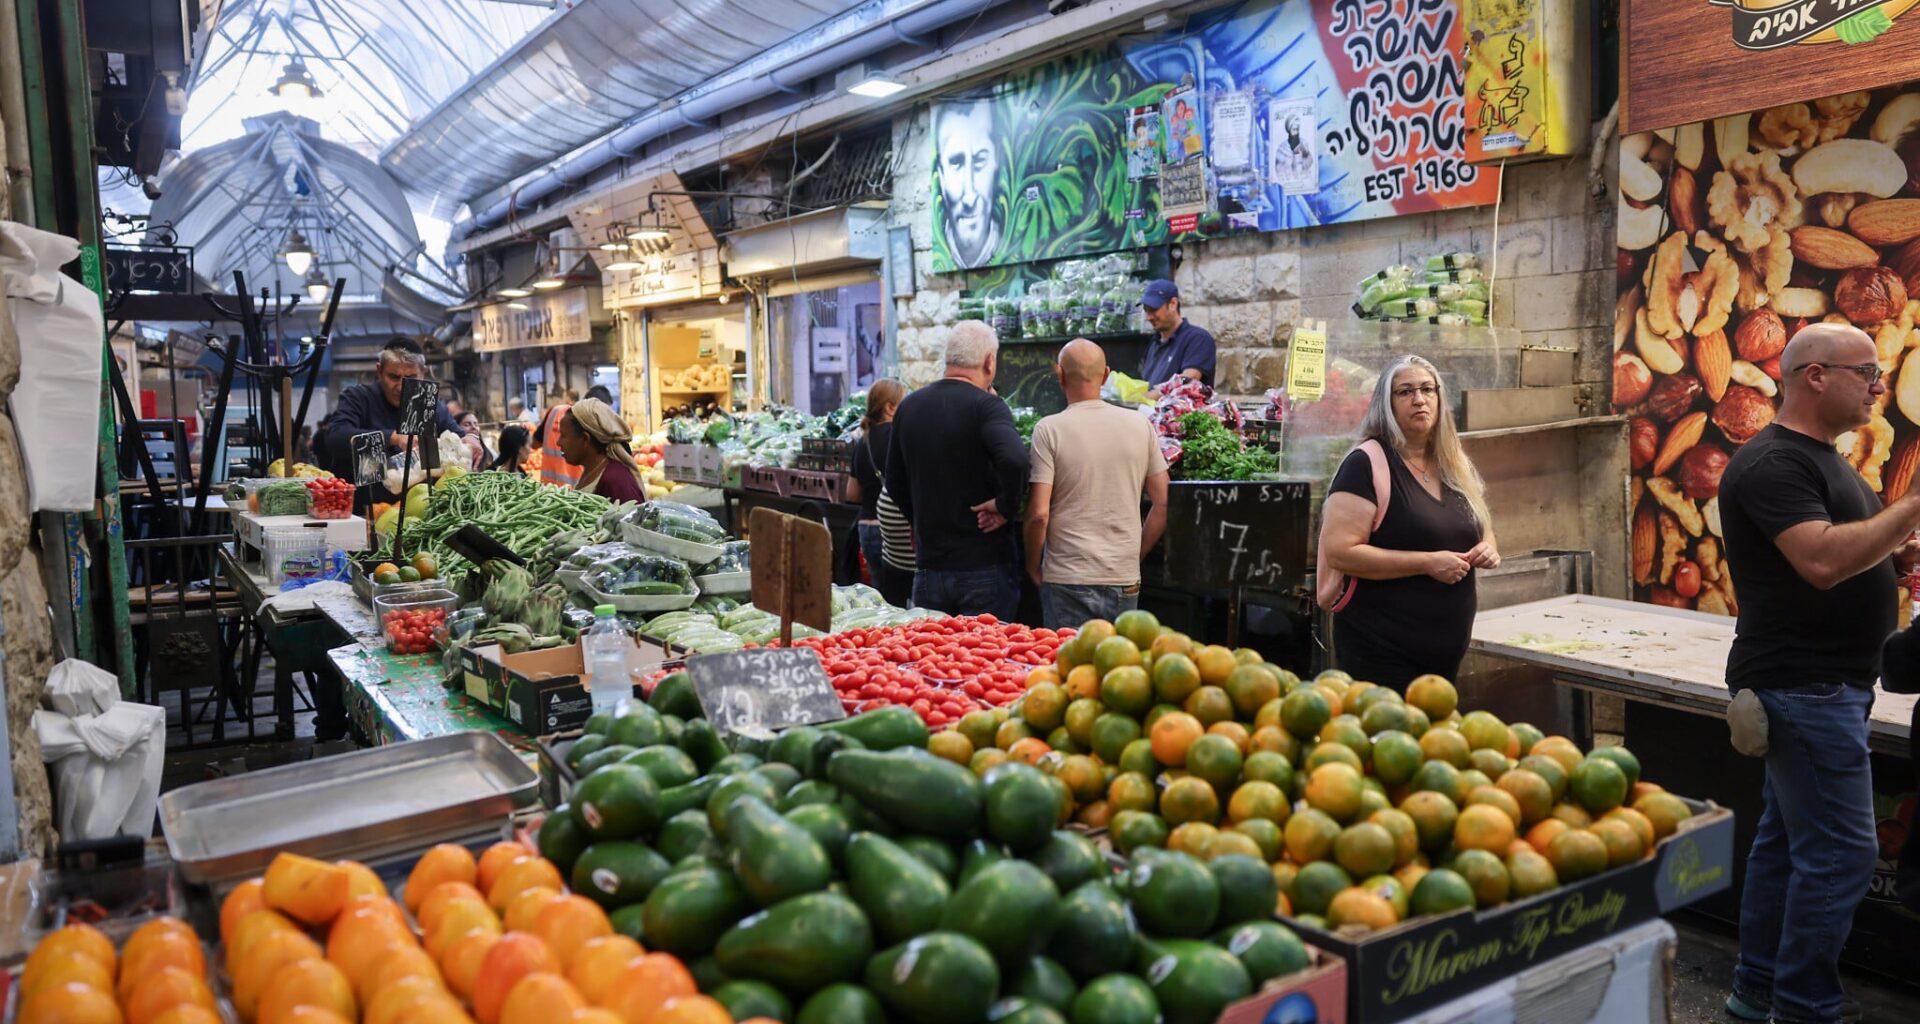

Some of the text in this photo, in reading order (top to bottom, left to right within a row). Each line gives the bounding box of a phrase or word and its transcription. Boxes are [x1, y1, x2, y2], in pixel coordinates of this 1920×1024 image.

[1347, 10, 1454, 67] משה
[1325, 91, 1465, 157] טרוזיליה
[1364, 160, 1476, 202] EST 1960
[1219, 520, 1249, 581] 7
[1381, 888, 1627, 1005] Marom Top Quality
